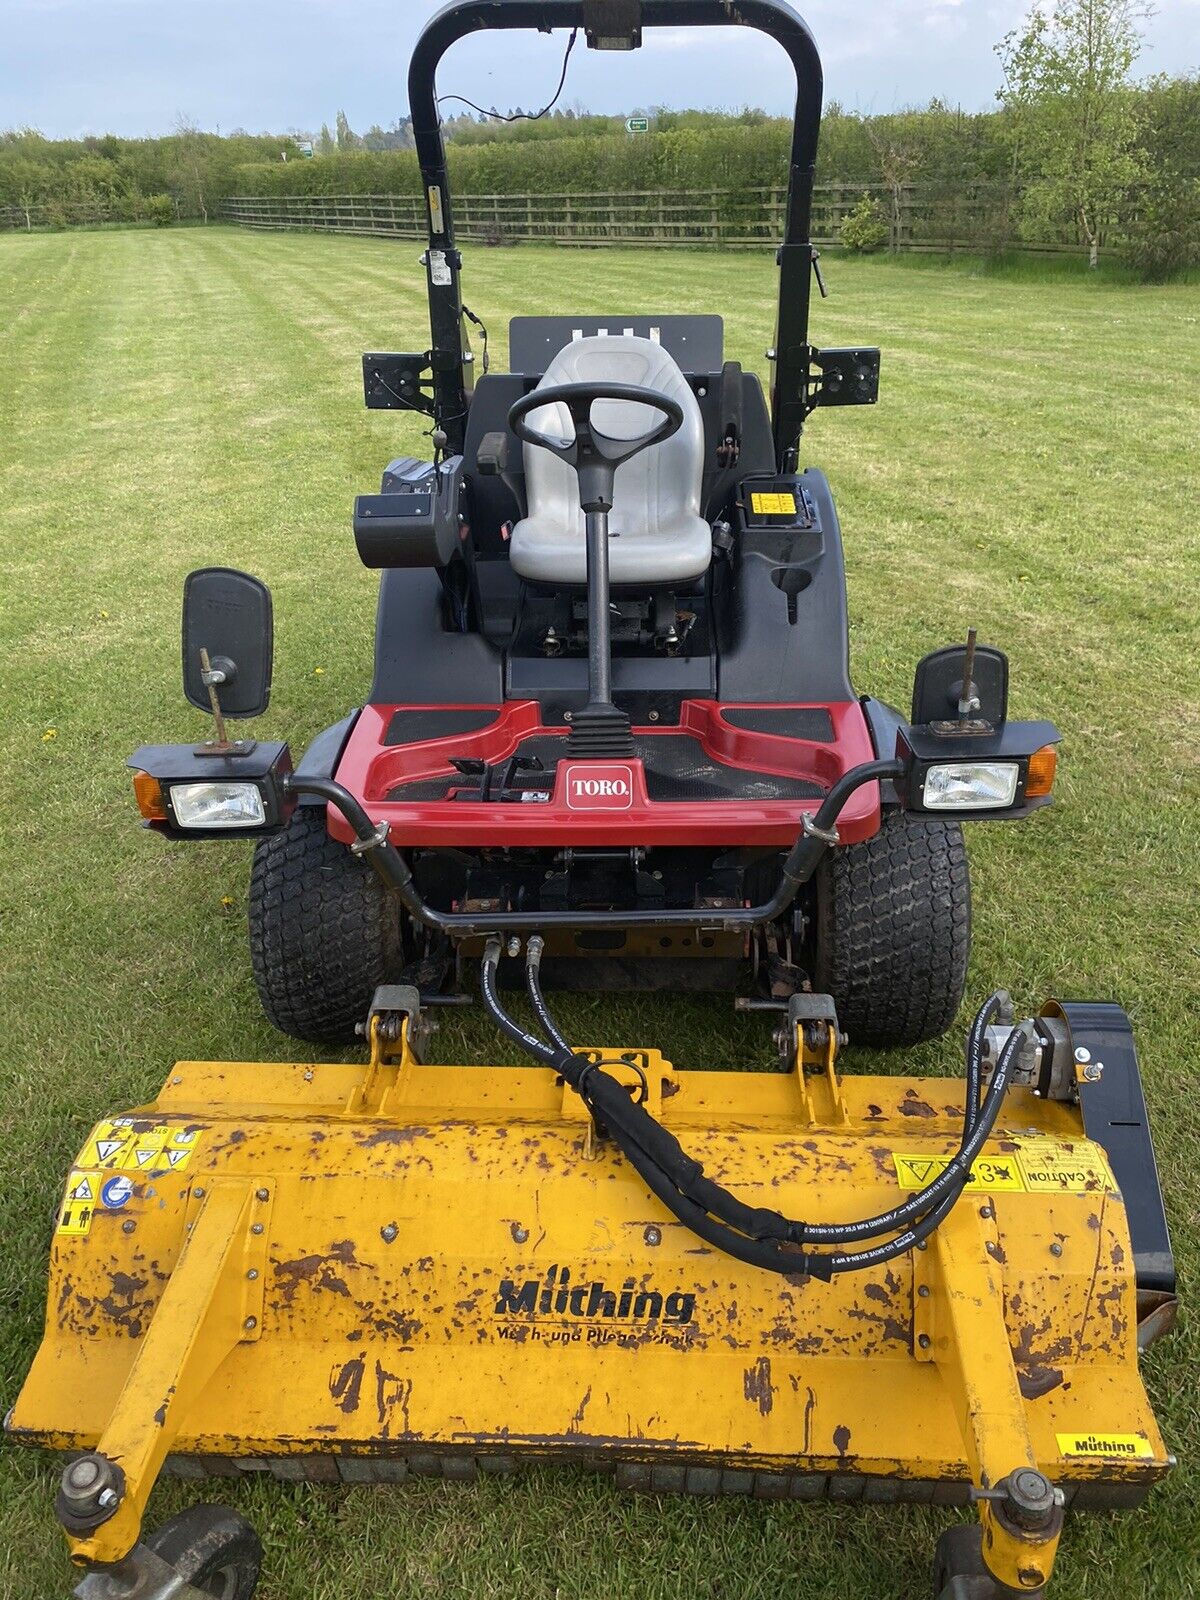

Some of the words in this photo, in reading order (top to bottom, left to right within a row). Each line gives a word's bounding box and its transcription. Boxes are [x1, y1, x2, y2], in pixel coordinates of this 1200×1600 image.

[1027, 1172, 1086, 1182] CAUTION
[494, 1264, 696, 1324] Müthing
[1075, 1436, 1136, 1453] Müthing
